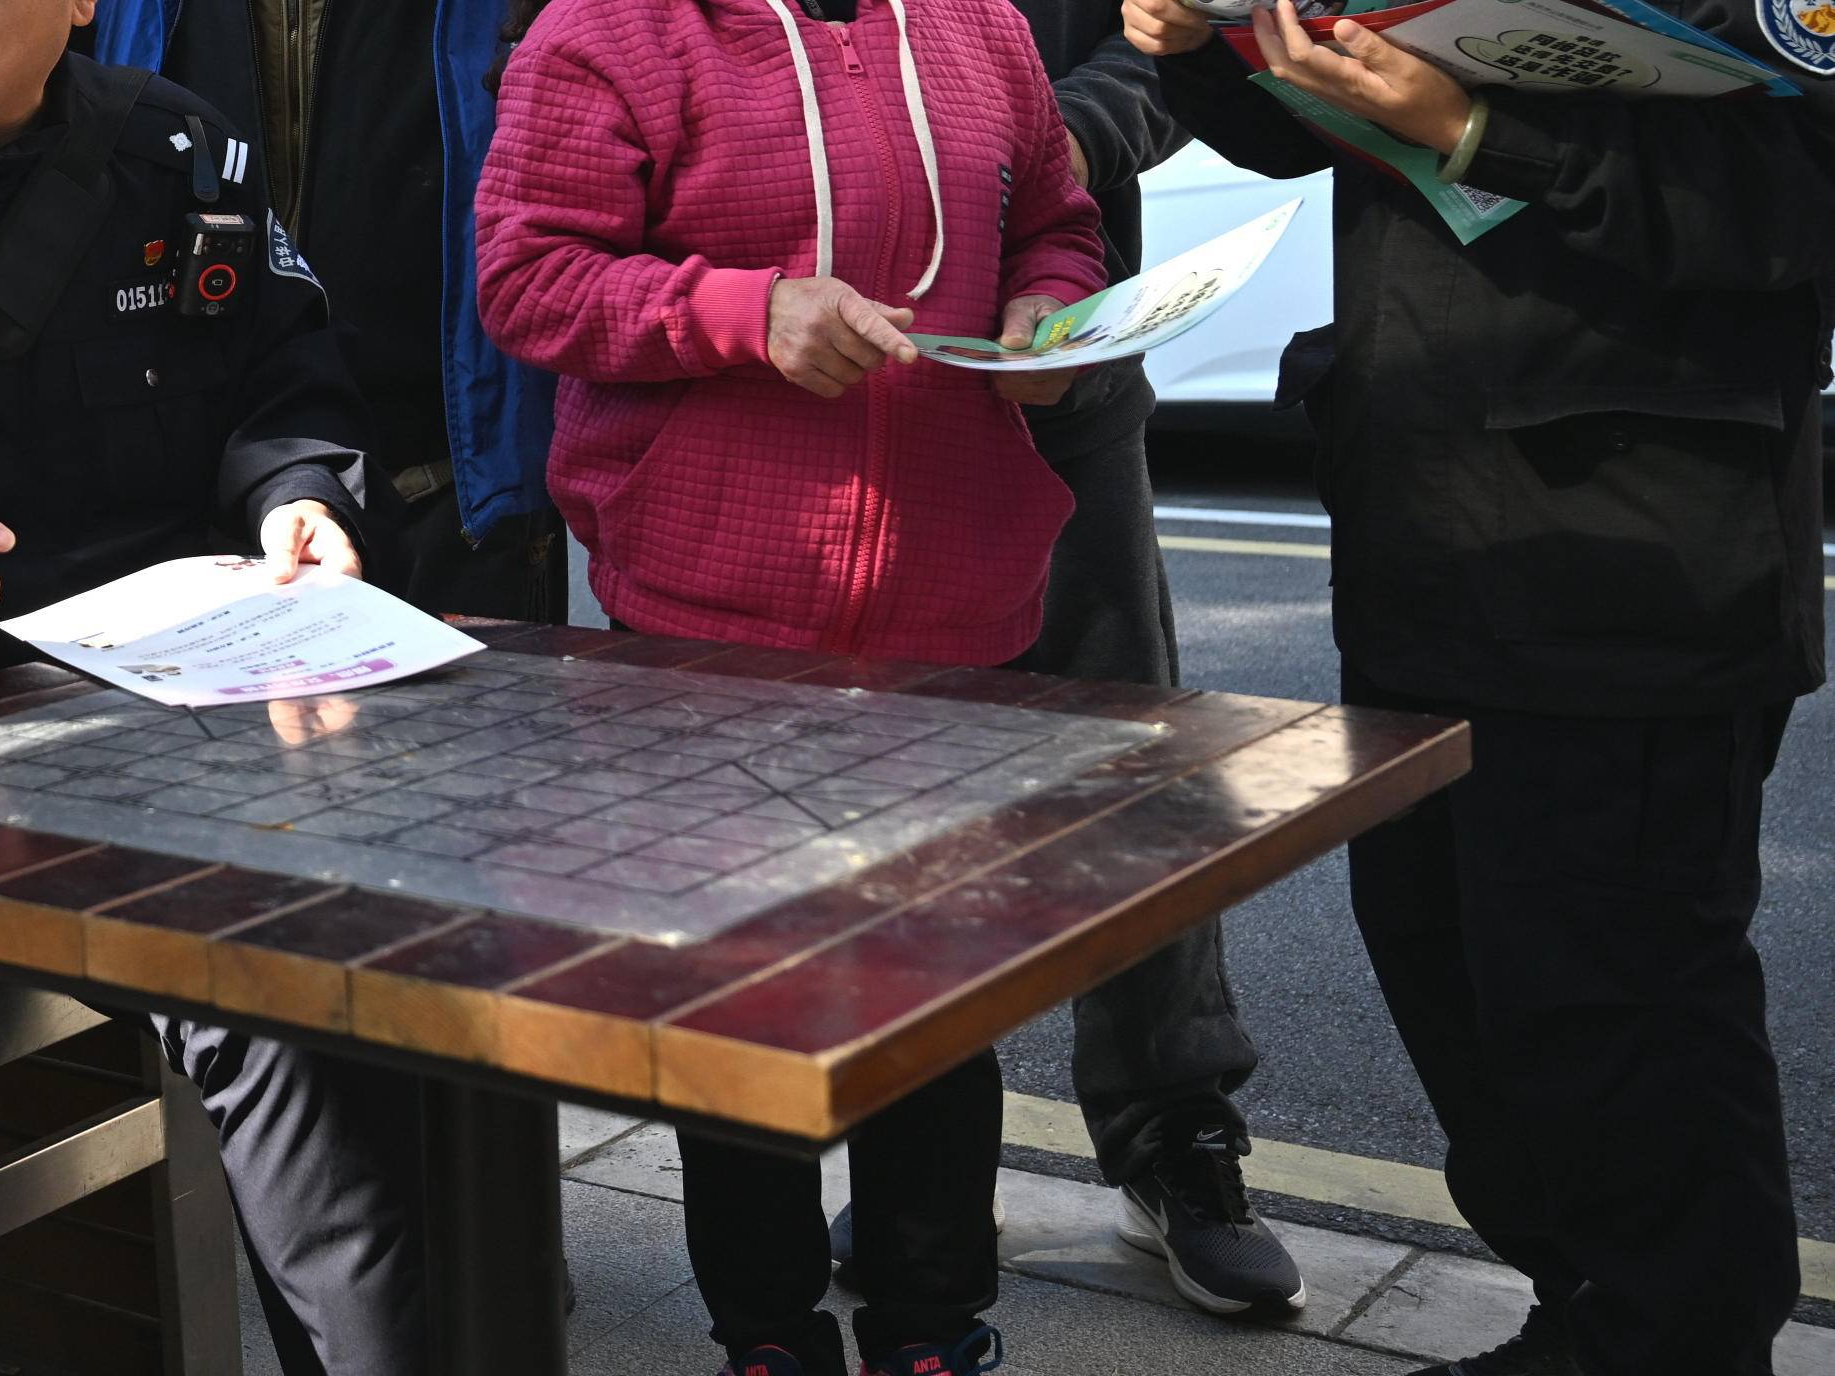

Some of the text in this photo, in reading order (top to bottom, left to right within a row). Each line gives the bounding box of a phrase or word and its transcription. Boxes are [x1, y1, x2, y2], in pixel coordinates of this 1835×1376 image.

[1527, 33, 1622, 63] 网络贷款
[273, 218, 296, 268] 中华人民
[116, 282, 170, 312] 01511
[914, 1355, 942, 1375] ANTA
